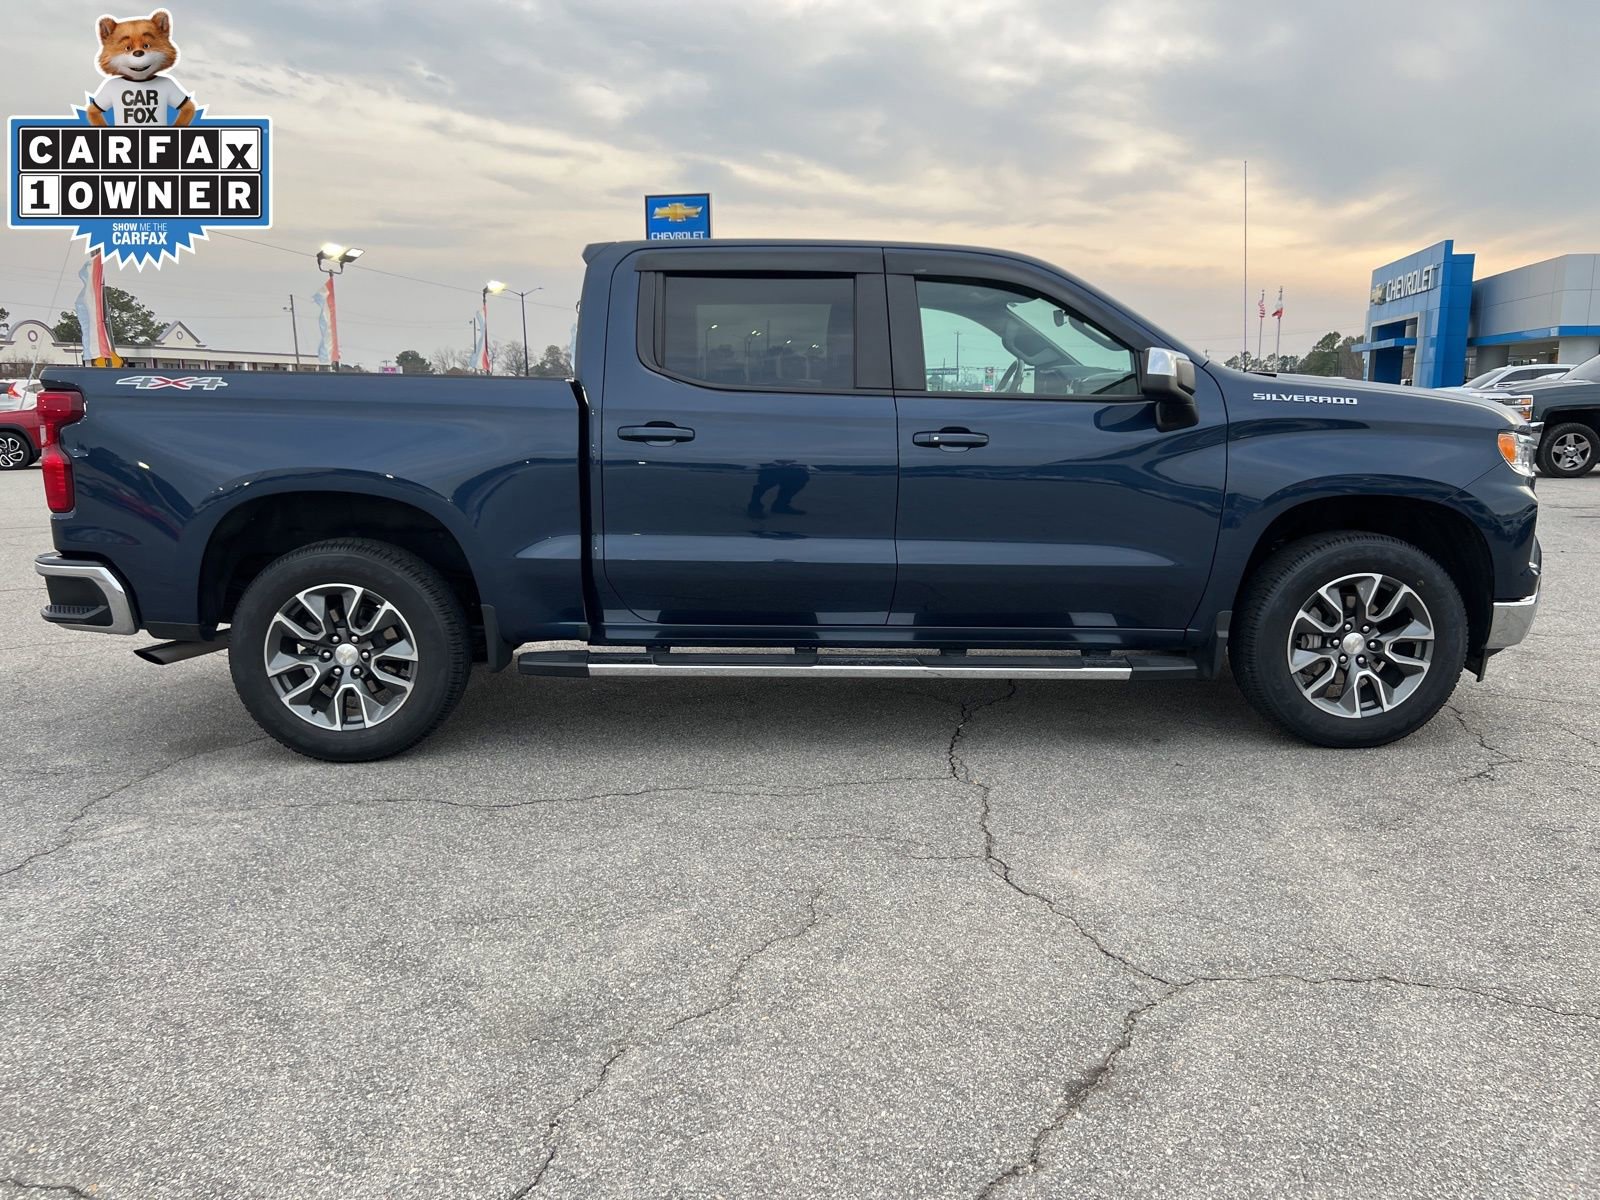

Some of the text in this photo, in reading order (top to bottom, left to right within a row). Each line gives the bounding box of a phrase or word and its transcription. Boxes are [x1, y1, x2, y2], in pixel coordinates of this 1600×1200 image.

[651, 231, 704, 240] CHEVROLET
[1386, 265, 1434, 302] CHEVROLET
[1252, 393, 1358, 405] SILVERADO
